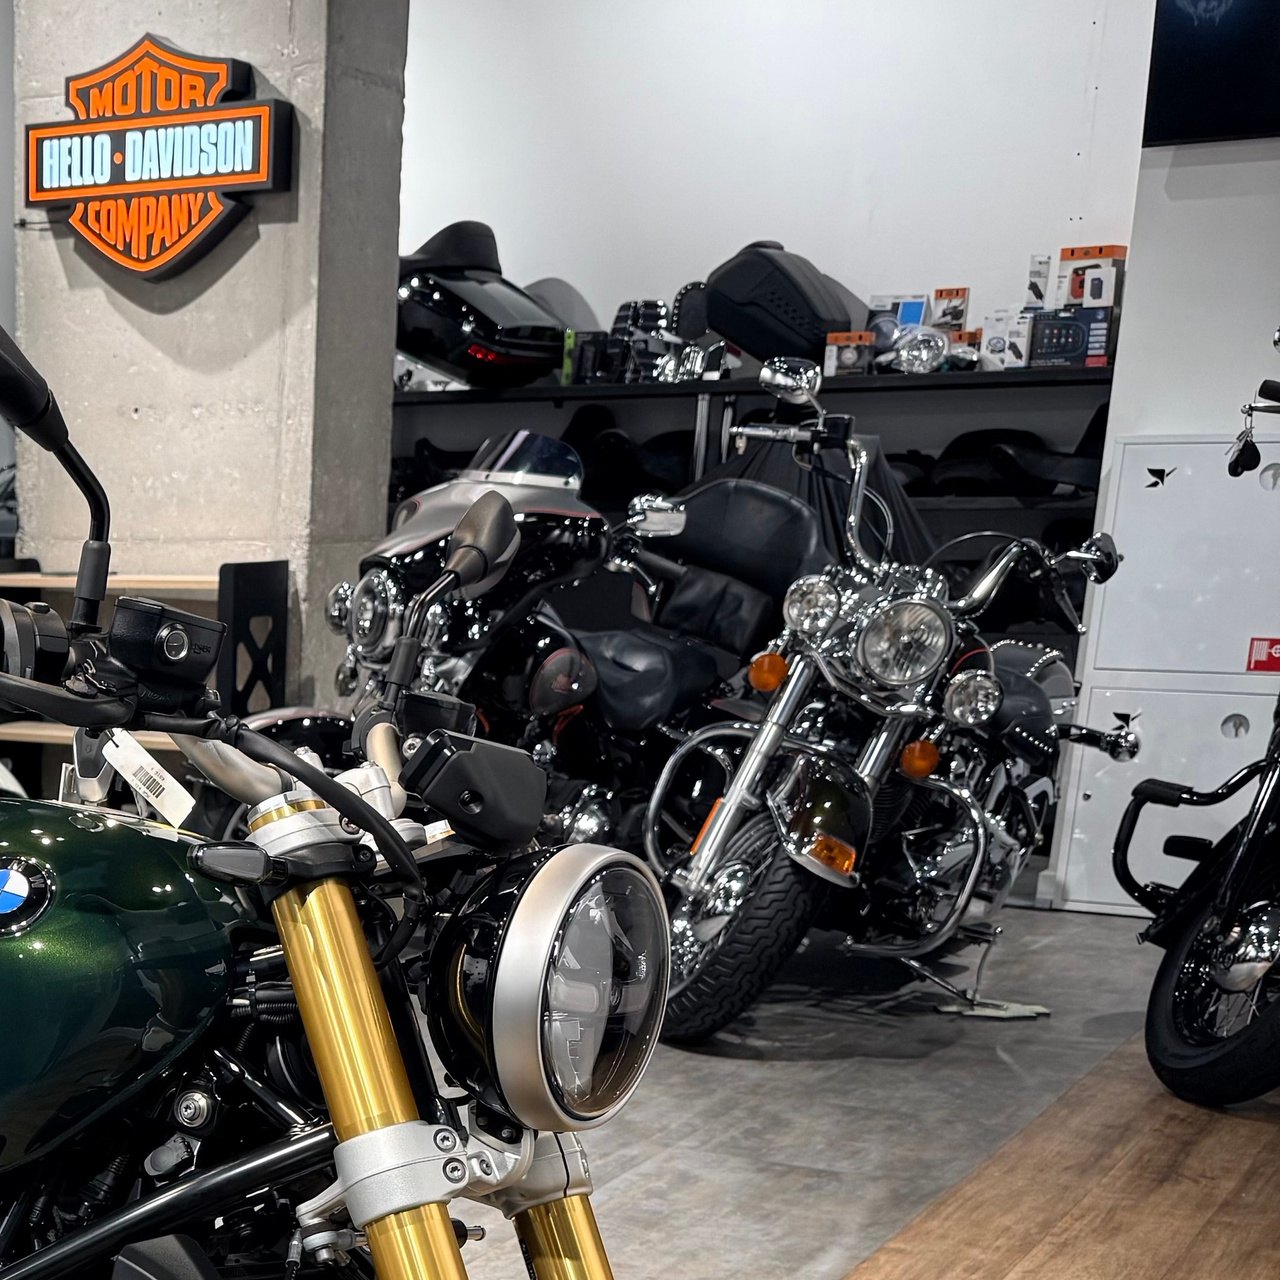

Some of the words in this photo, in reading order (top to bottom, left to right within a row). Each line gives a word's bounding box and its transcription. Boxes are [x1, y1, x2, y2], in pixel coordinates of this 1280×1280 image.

[89, 57, 206, 118] MOTOR
[42, 133, 111, 188] HELLO
[125, 119, 253, 182] DAVIDSON
[87, 192, 205, 259] COMPANY
